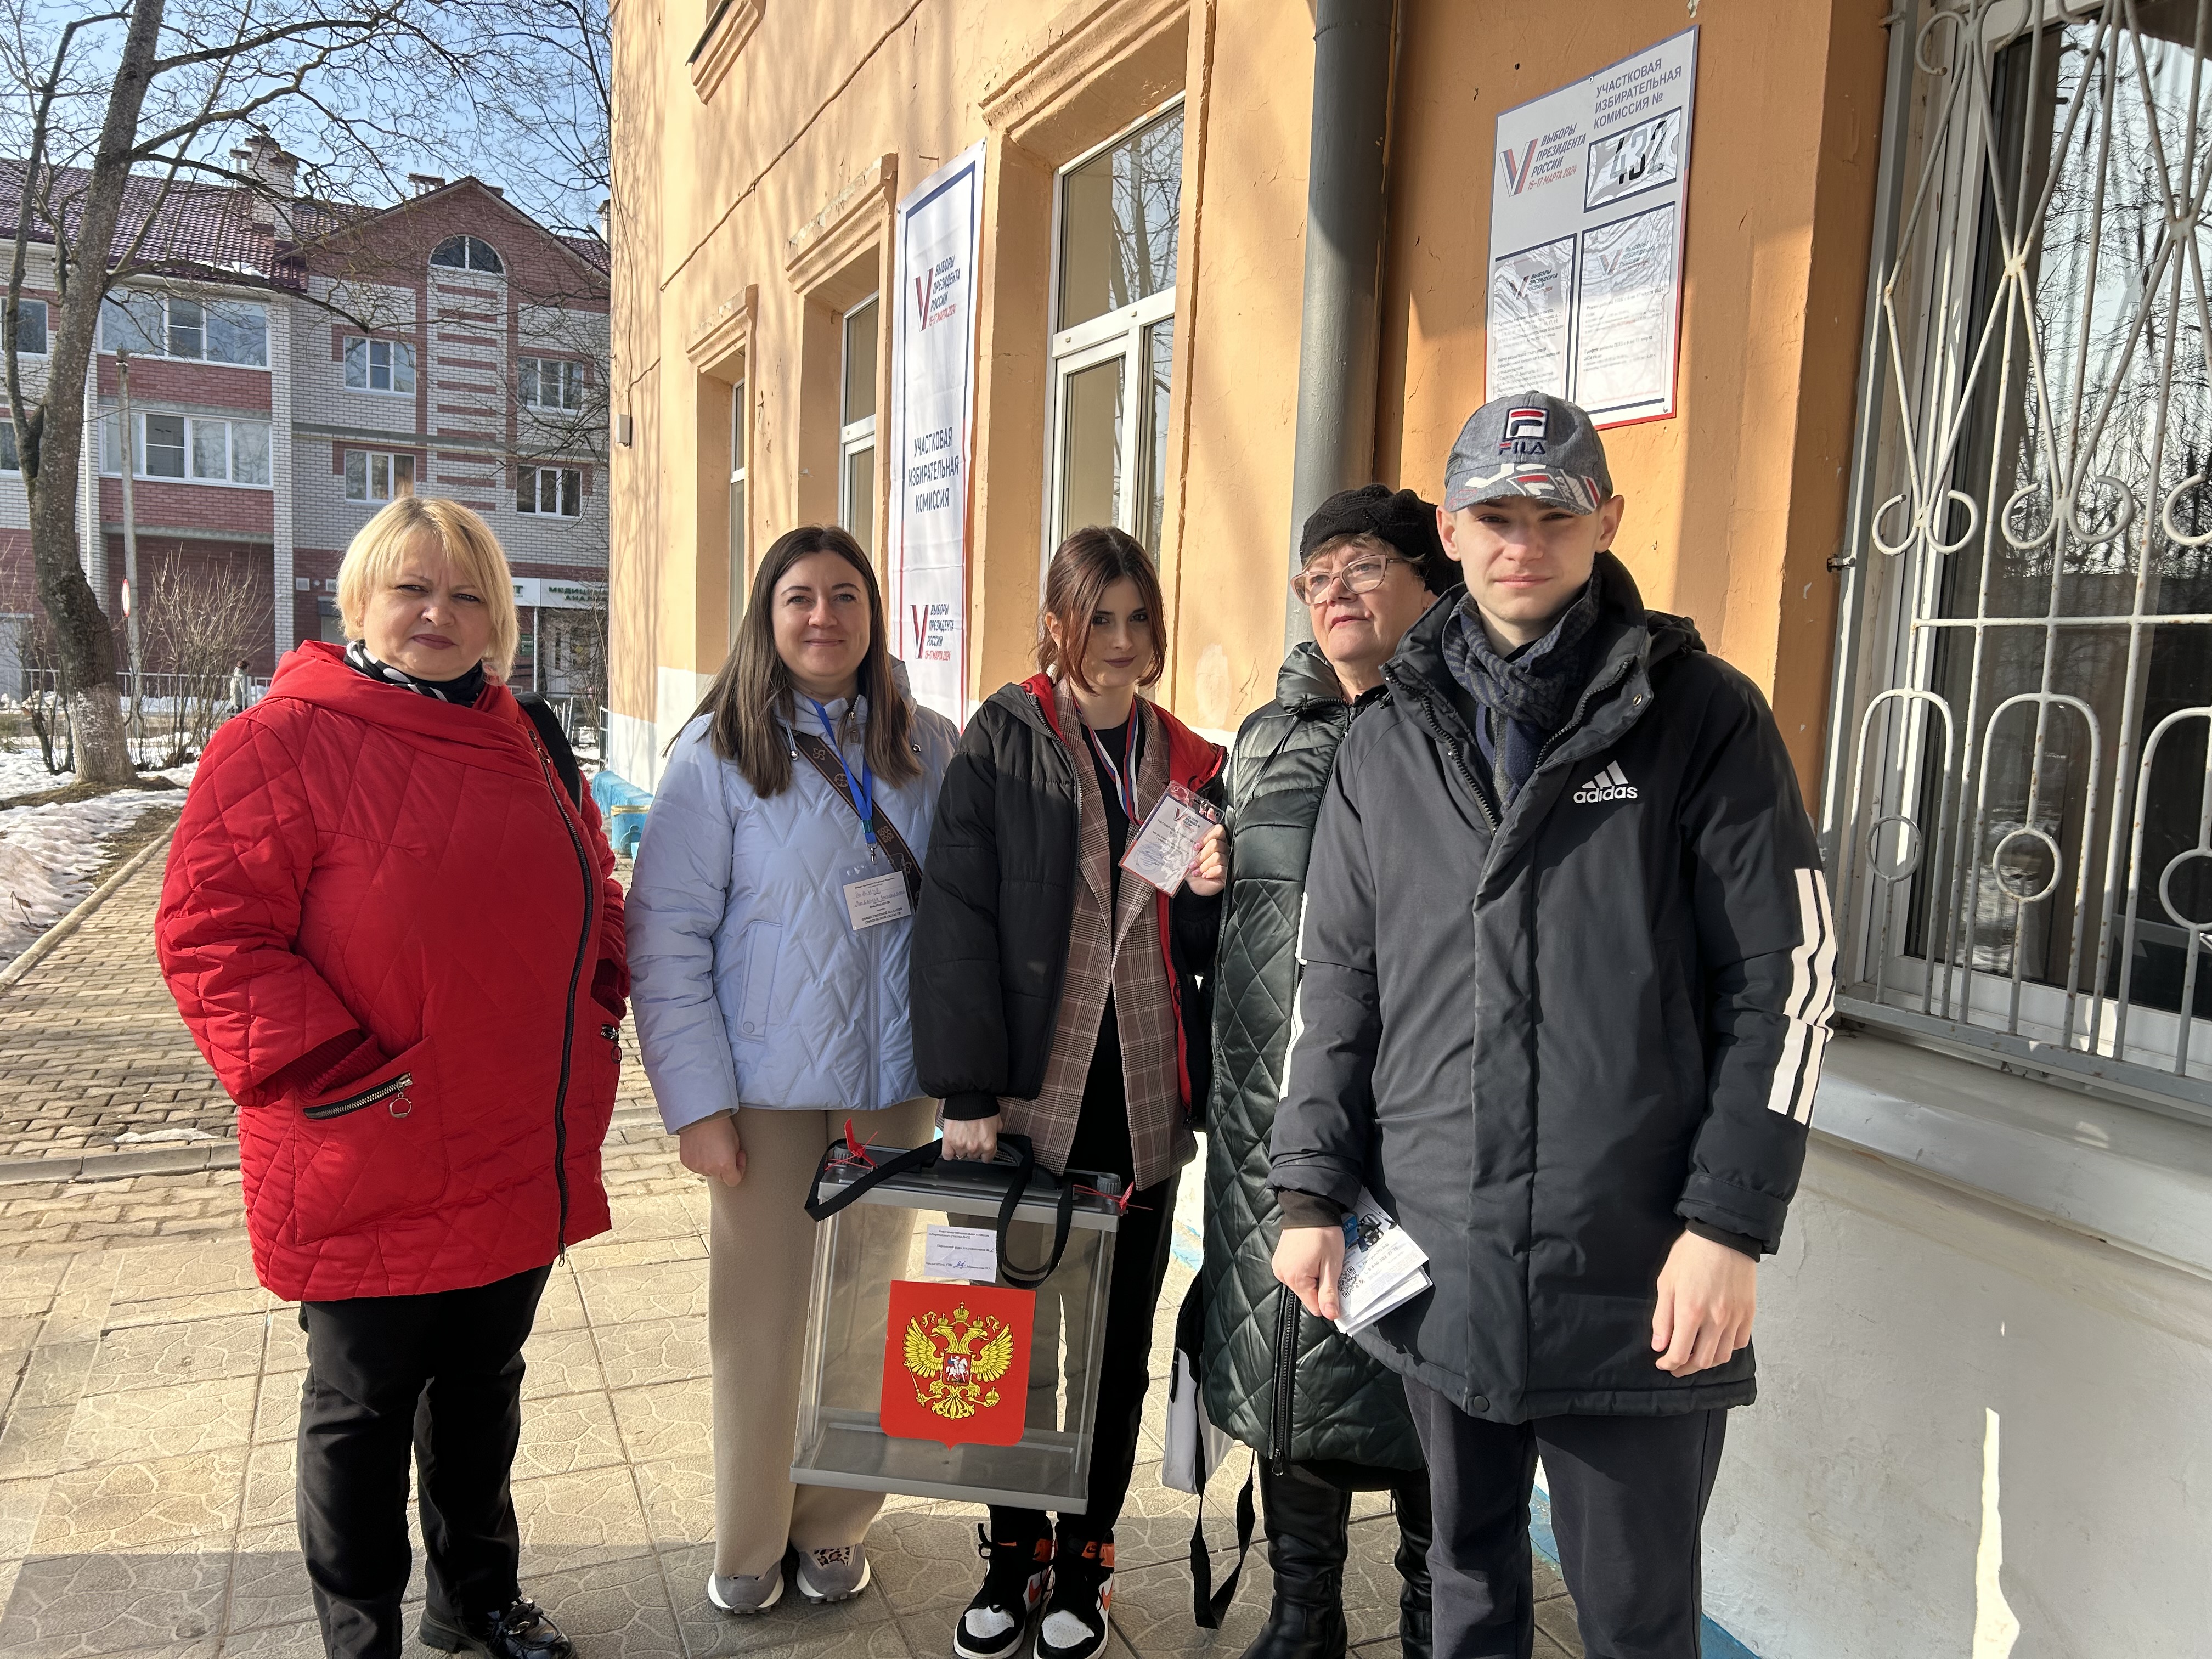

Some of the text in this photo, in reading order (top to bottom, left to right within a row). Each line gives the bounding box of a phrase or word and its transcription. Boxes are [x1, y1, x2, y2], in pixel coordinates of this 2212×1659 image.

[1595, 65, 1681, 114] ИЗБИРАТЕЛЬНАЯ
[1596, 58, 1662, 98] УЧАСТКОВАЯ
[1594, 92, 1663, 129] КОМИССИЯ №
[1541, 122, 1577, 146] ВЫБОРЫ
[1536, 133, 1586, 162] ПРЕЗИДЕНТА
[1531, 156, 1564, 178] РОССИИ
[1543, 170, 1561, 185] МАРТА
[1562, 164, 1577, 178] 2024
[935, 254, 955, 277] ВЫБОРЫ
[933, 268, 960, 295] ПРЕЗИДЕНТА
[930, 291, 948, 312] РОССИИ
[914, 426, 952, 458] УЧАСТКОВАЯ
[1498, 441, 1545, 456] FILA
[909, 455, 959, 487] ИЗБИРАТЕЛЬНАЯ
[916, 487, 949, 514] КОМИССИЯ
[930, 603, 949, 616] ВЫБОРЫ
[929, 619, 954, 633] ПРЕЗИДЕНТА
[927, 635, 944, 647] РОССИИ
[1573, 785, 1638, 804] adidas
